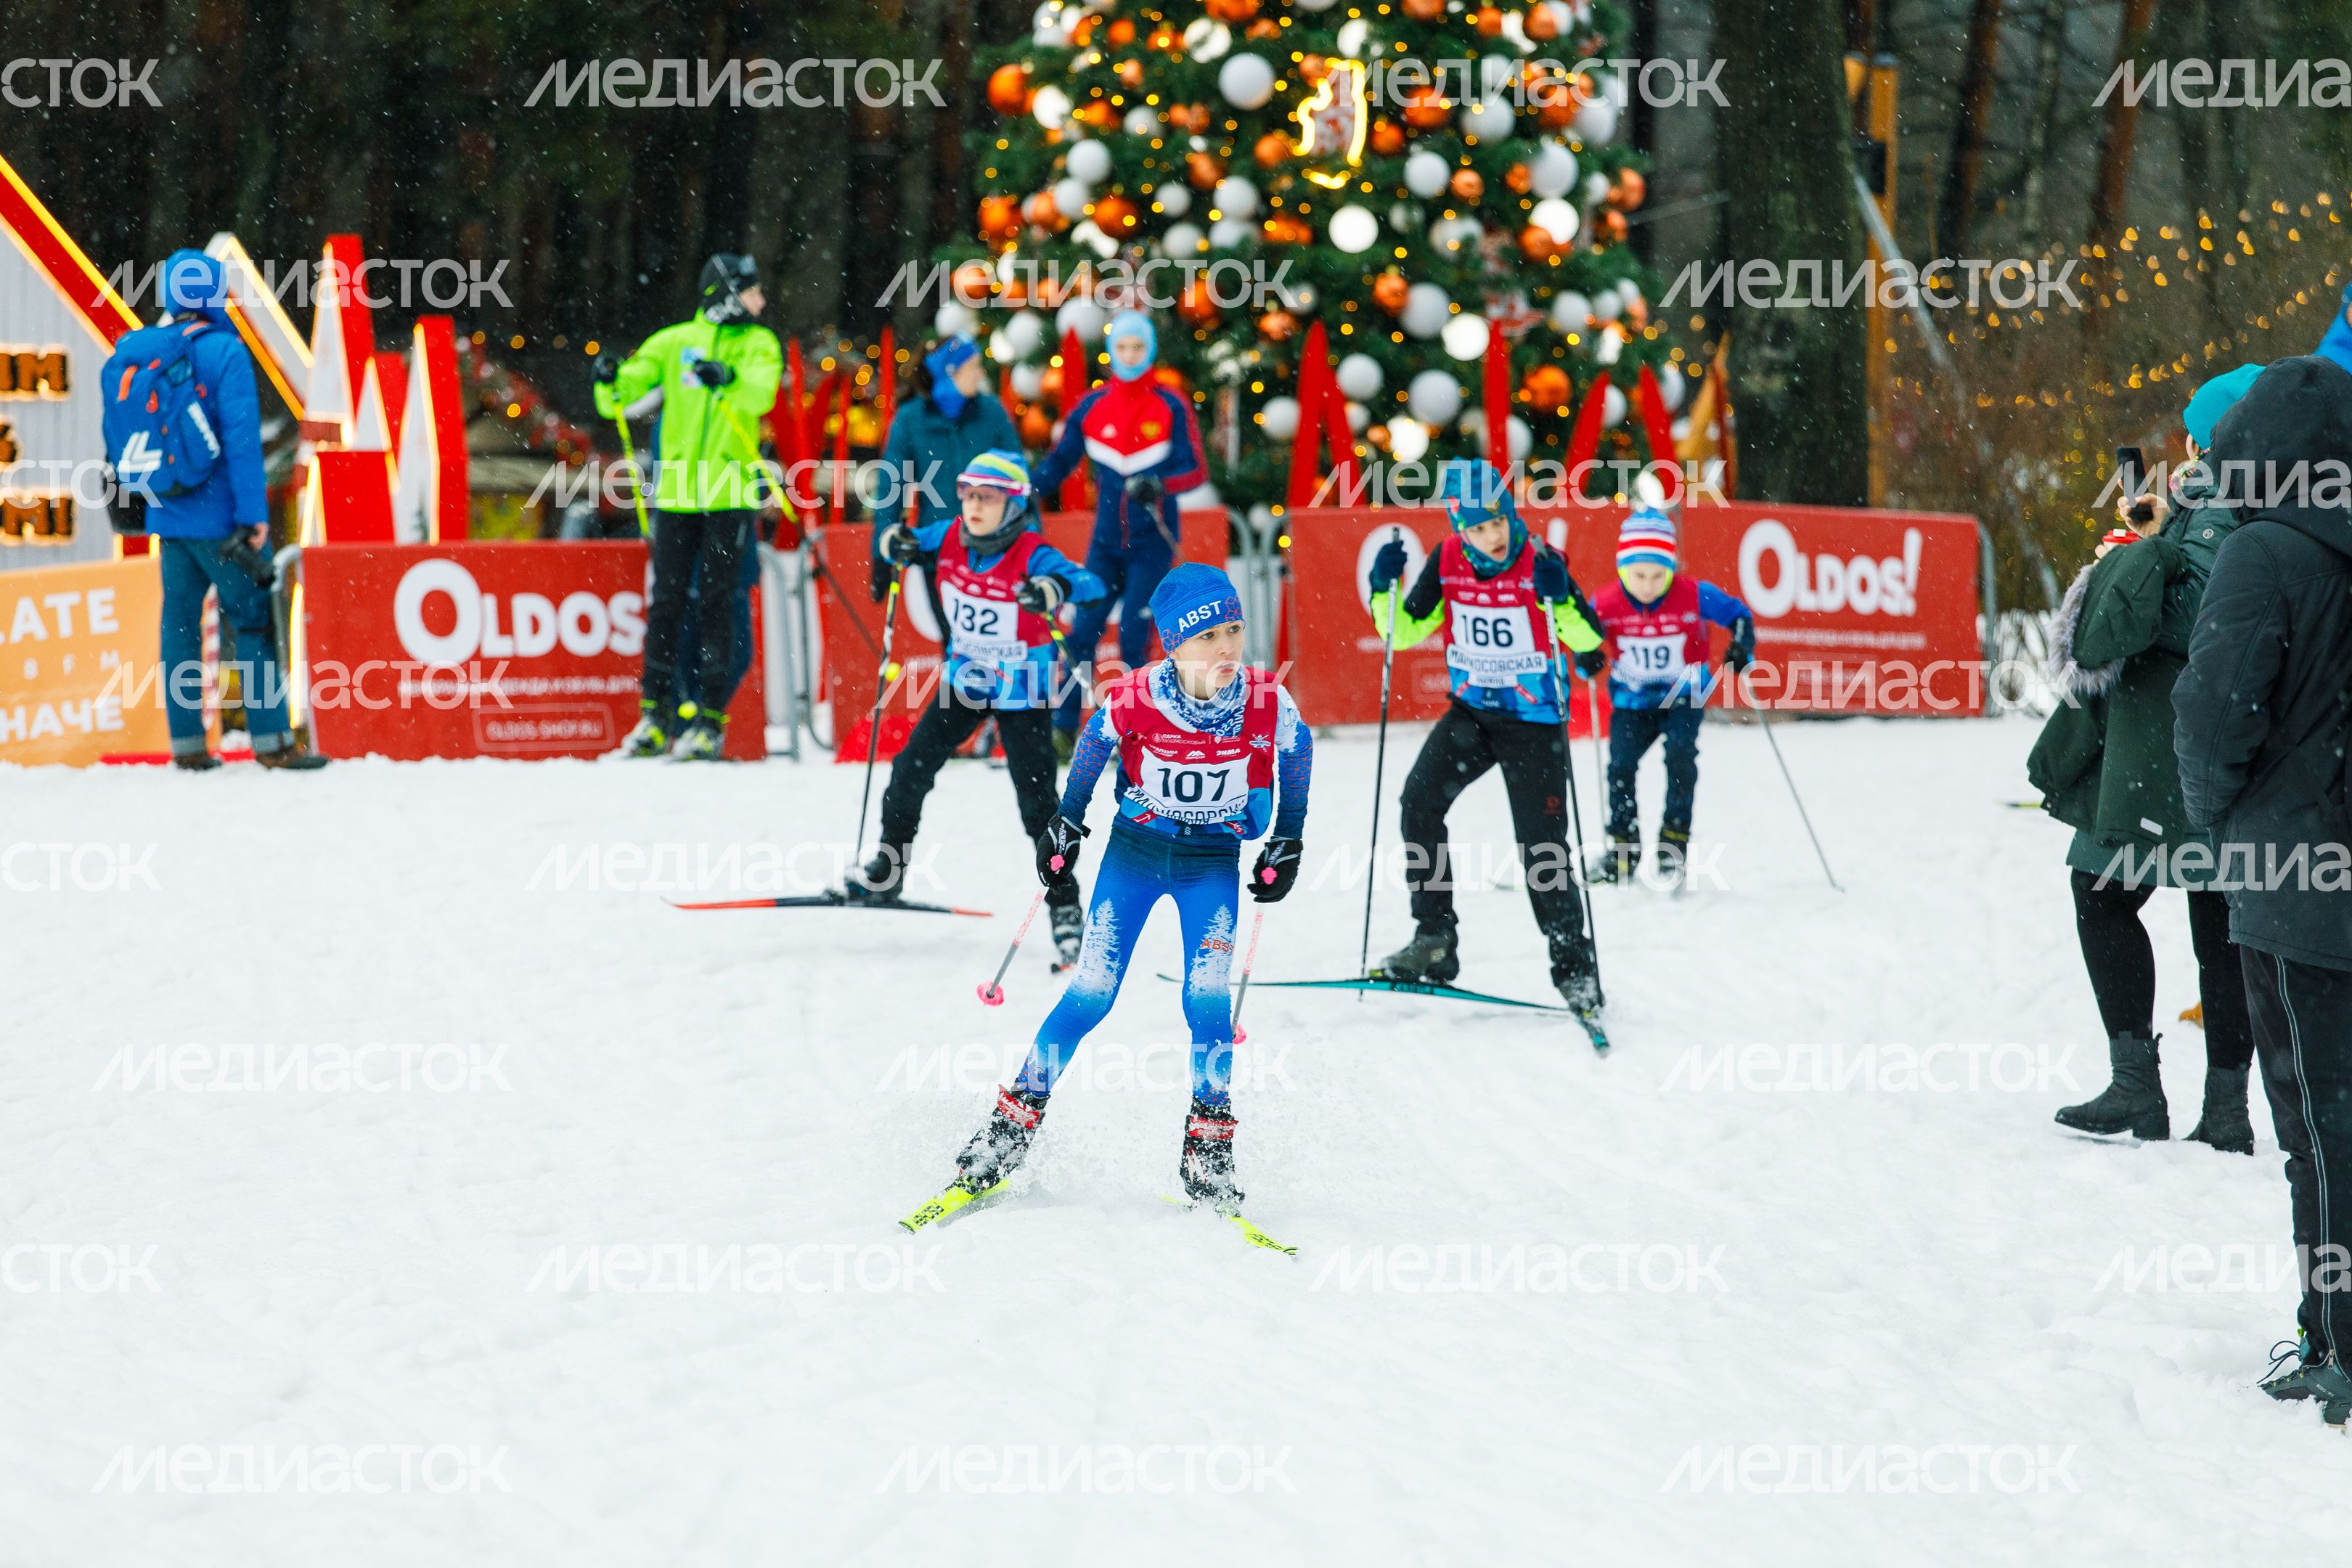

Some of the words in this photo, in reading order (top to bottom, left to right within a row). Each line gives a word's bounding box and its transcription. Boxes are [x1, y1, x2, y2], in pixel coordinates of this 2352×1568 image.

[953, 598, 998, 635] 132
[1177, 600, 1222, 633] ABST
[1461, 615, 1513, 648] 166
[1630, 645, 1670, 669] 119
[1157, 767, 1230, 803] 107
